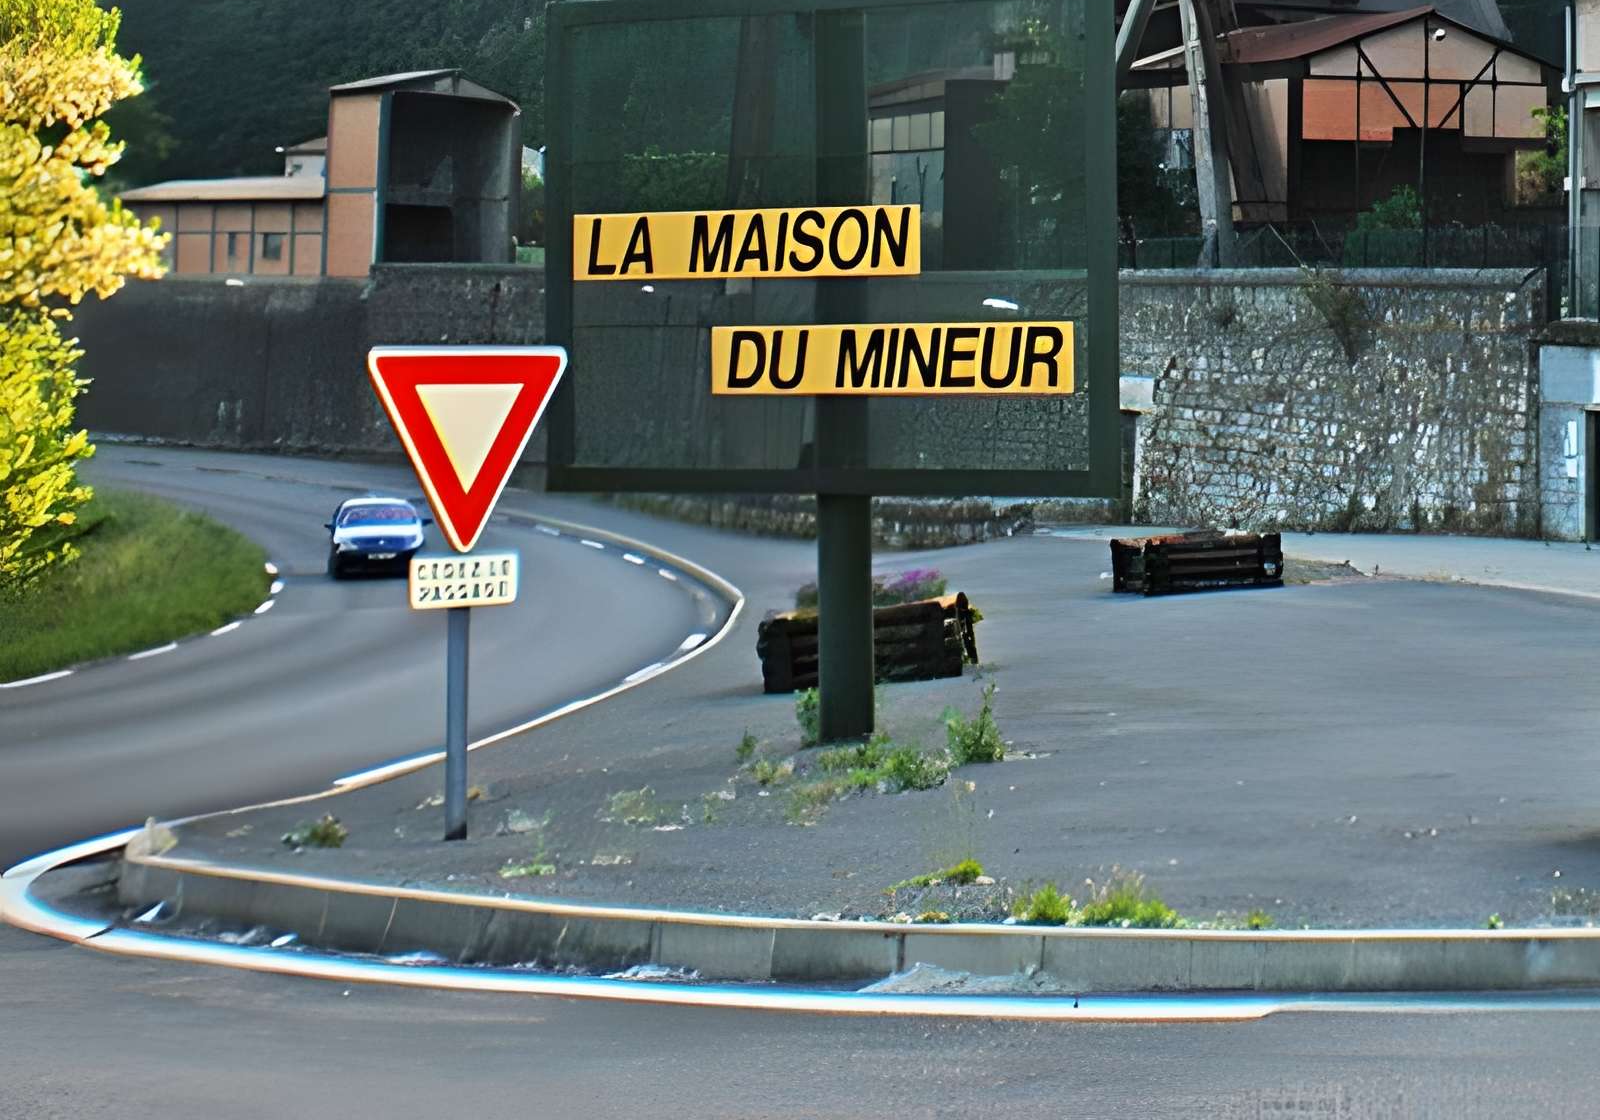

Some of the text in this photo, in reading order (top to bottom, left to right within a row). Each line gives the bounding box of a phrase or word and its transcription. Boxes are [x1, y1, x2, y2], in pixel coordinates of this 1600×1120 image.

[587, 207, 911, 275] LA MAISON
[727, 326, 1064, 389] DU MINEUR
